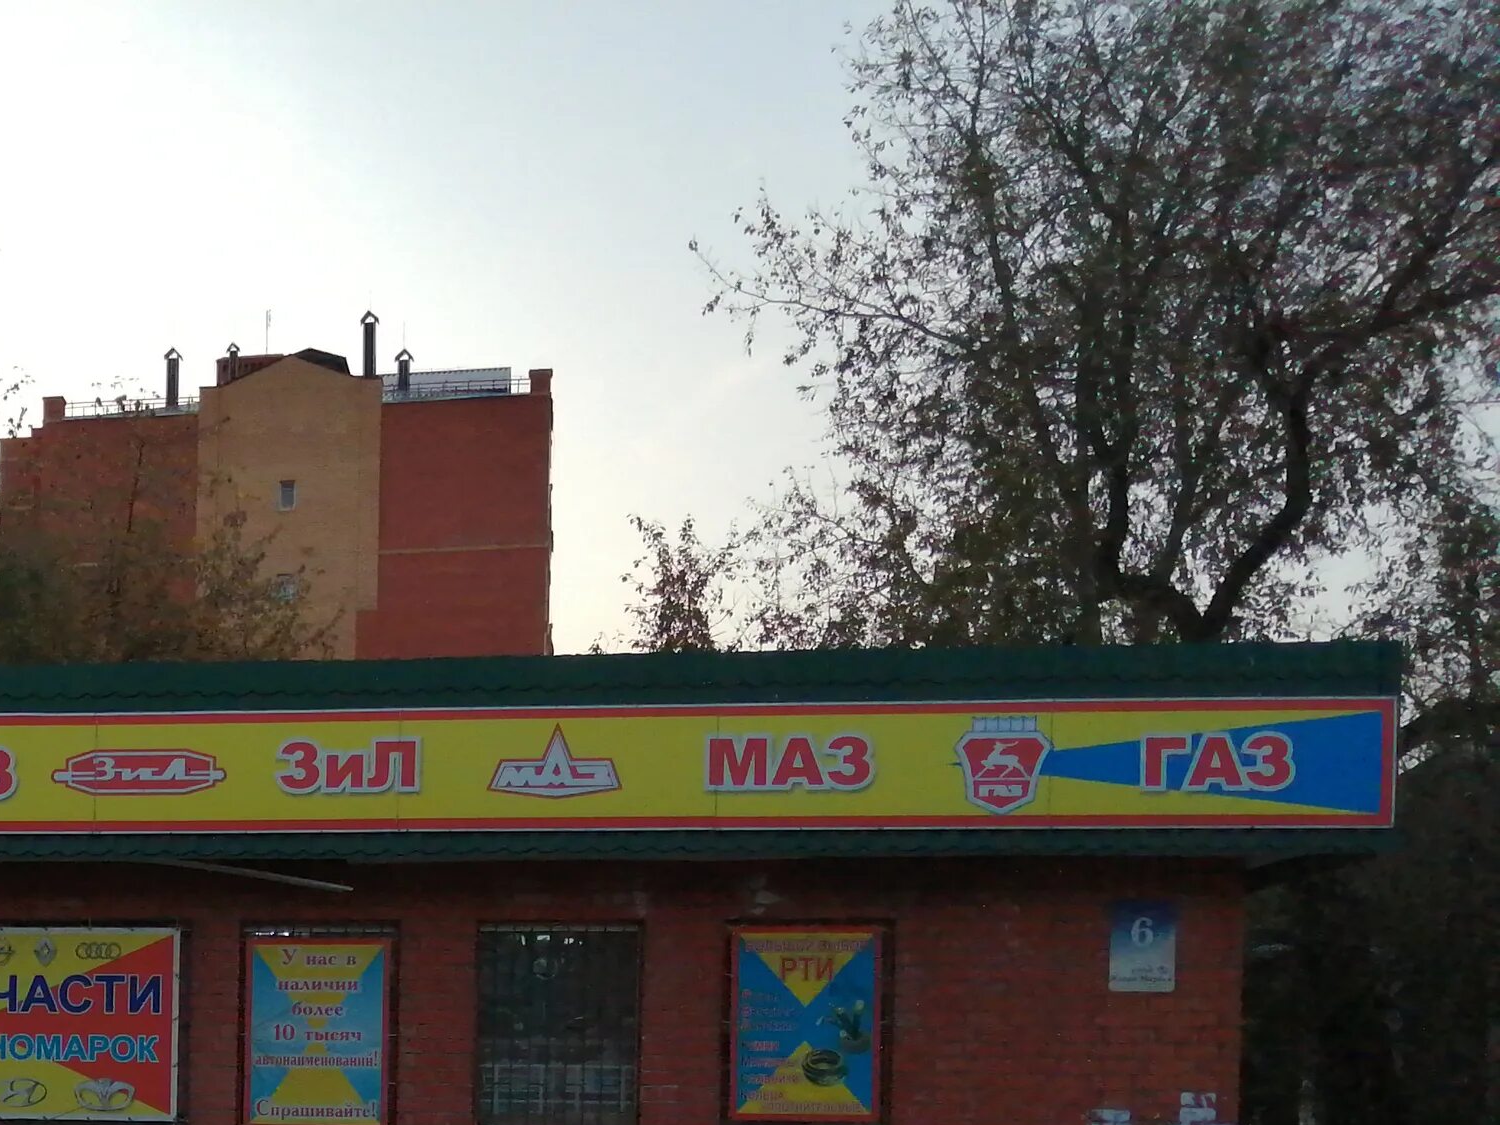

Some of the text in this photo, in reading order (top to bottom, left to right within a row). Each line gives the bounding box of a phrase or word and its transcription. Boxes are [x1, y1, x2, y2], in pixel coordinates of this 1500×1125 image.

[278, 737, 419, 792] ЗиЛ
[707, 735, 874, 788] МАЗ
[1144, 734, 1293, 789] ГАЗ
[1131, 917, 1154, 946] 6
[281, 948, 357, 966] У нас в
[780, 956, 835, 982] РТИ
[278, 979, 359, 991] наличии
[291, 1002, 345, 1016] более
[273, 1024, 362, 1042] 10 тысяч
[256, 1099, 377, 1120] Спрашивайте!
